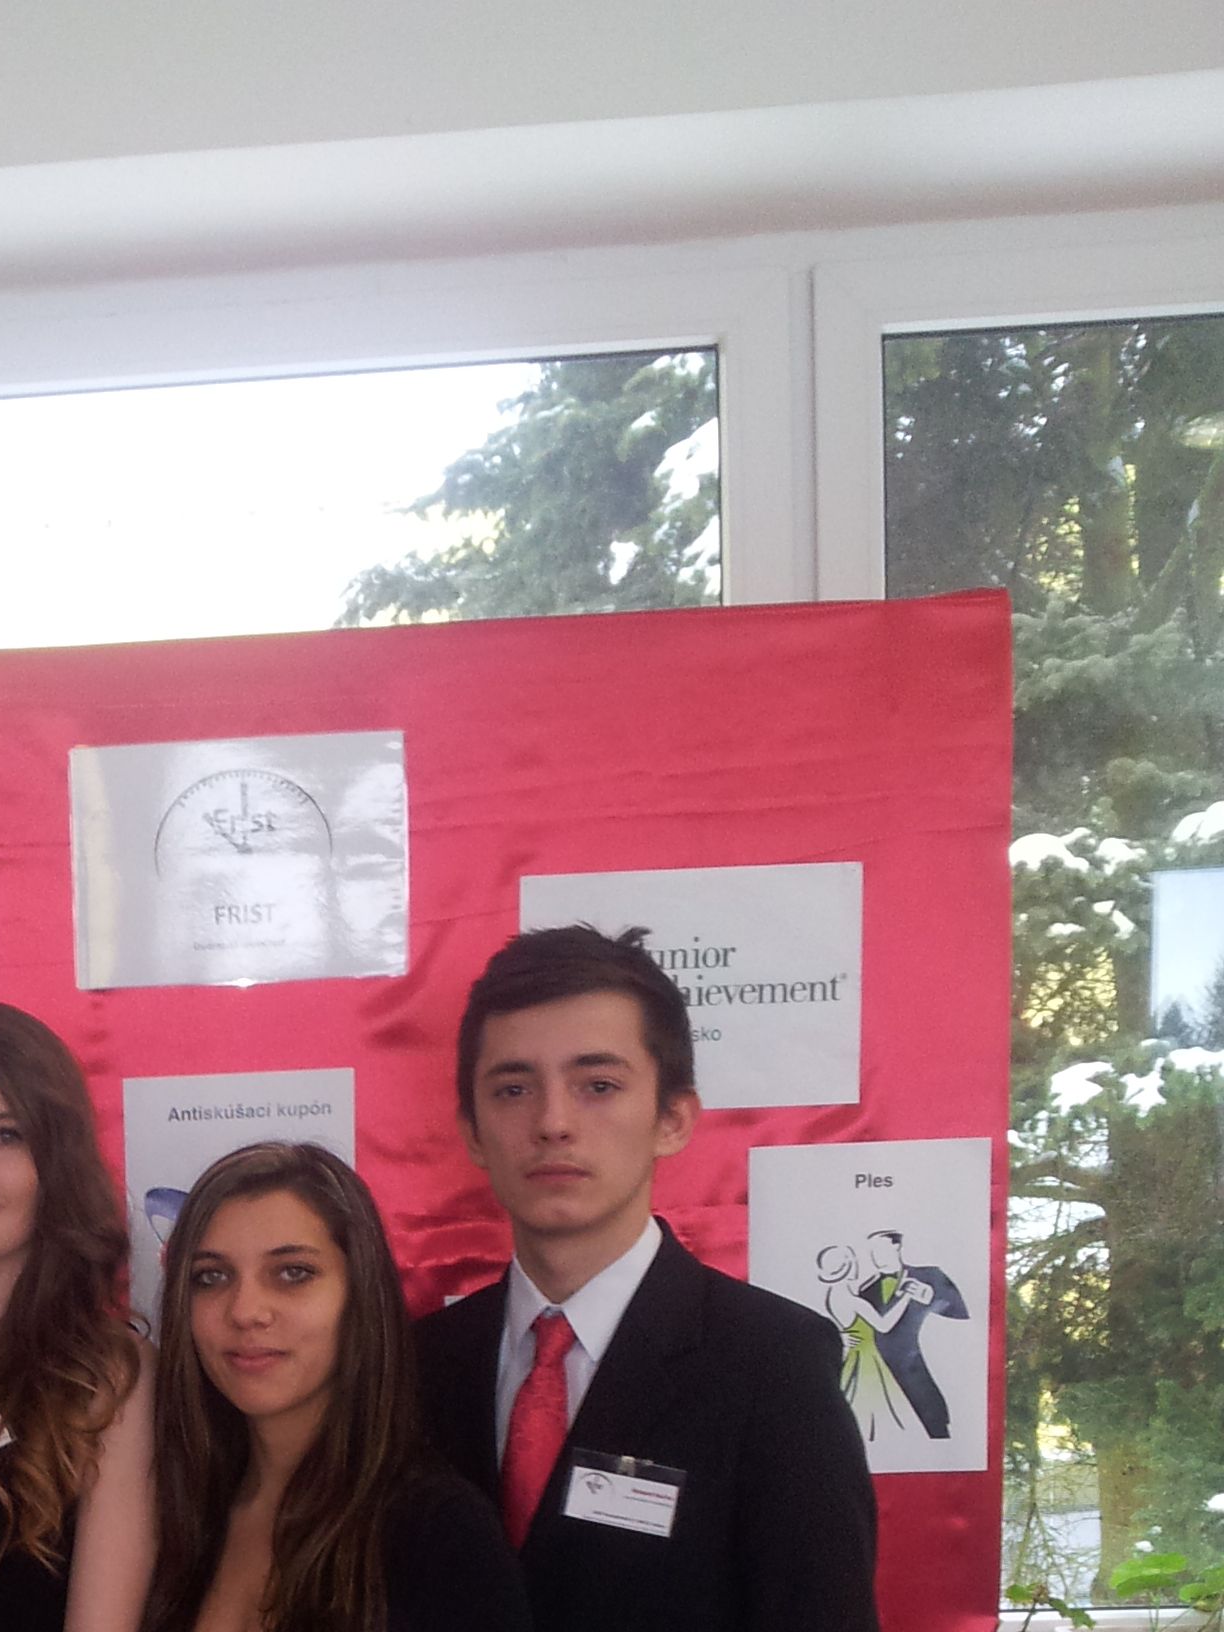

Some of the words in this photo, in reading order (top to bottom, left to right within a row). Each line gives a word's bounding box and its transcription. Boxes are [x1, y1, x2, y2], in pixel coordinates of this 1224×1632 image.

[214, 902, 274, 925] FRIST
[650, 936, 737, 970] unior
[168, 1103, 271, 1122] Antiskúšací
[277, 1100, 332, 1119] kupón
[855, 1173, 894, 1189] Ples
